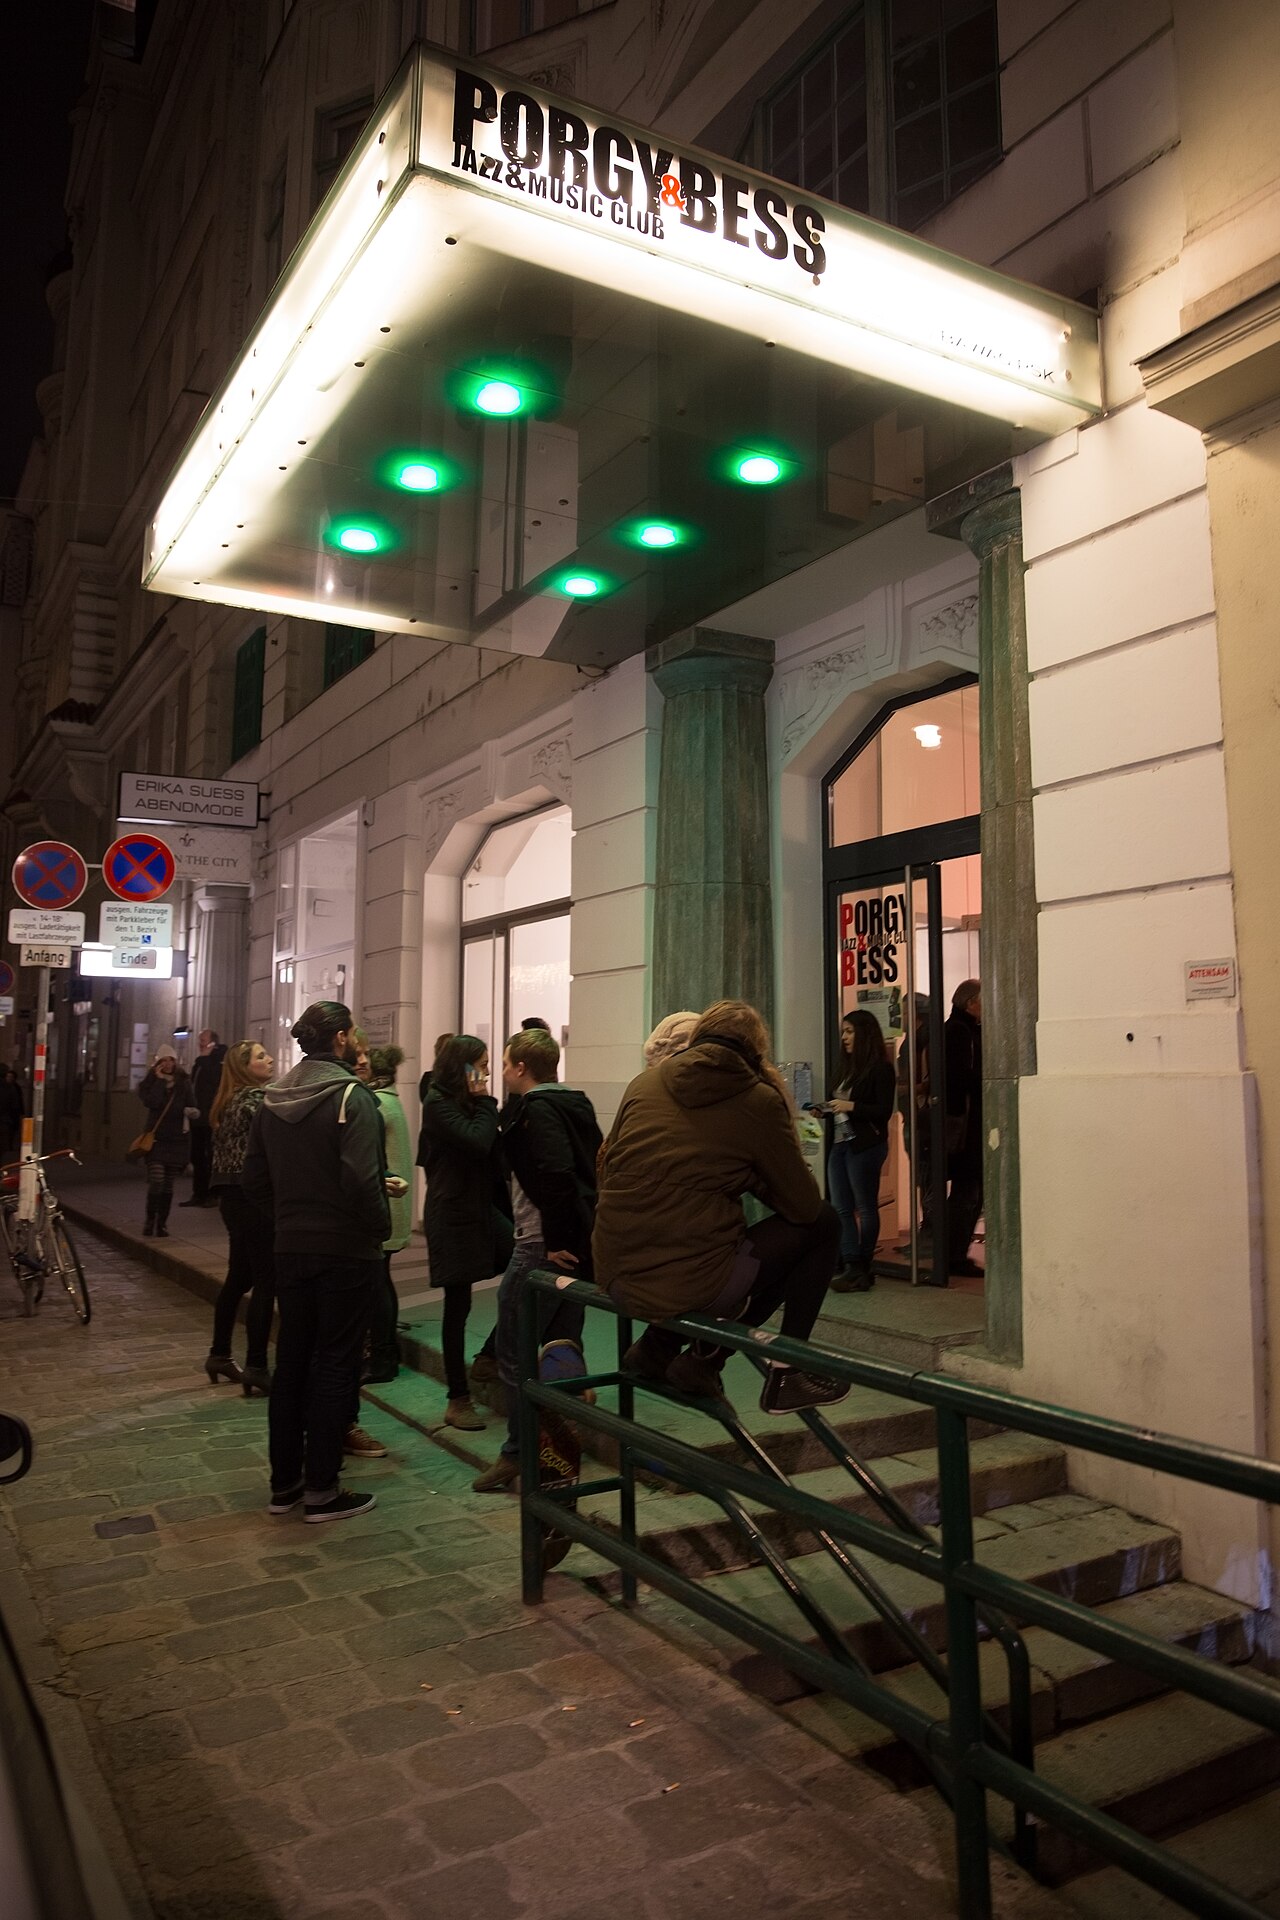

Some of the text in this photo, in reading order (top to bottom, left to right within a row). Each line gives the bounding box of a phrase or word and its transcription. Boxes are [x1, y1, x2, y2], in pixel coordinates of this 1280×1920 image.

[611, 201, 664, 239] CLUB
[136, 780, 244, 801] ERIKA SUESS
[135, 798, 244, 817] ABENDMODE
[186, 856, 209, 866] THE
[212, 857, 239, 868] CITY
[134, 906, 168, 915] Fahrzeuge
[25, 949, 64, 966] Anfang
[121, 953, 147, 965] Ende
[841, 944, 898, 987] BESS
